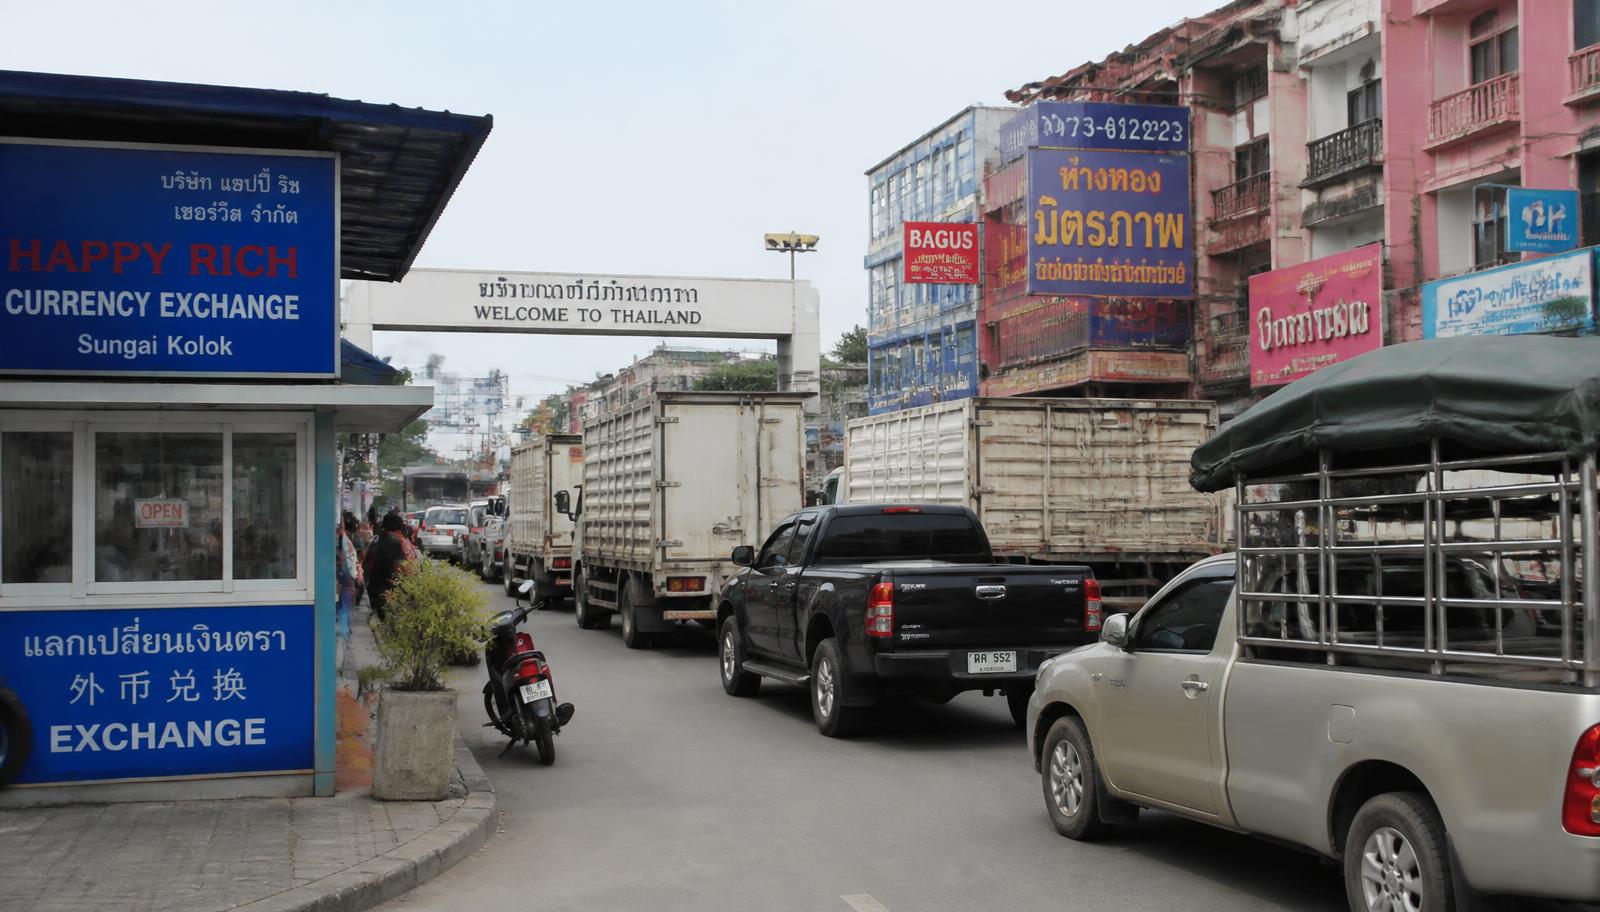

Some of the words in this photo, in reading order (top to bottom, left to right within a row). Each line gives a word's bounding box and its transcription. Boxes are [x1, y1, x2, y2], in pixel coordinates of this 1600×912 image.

[909, 229, 974, 250] BAGUS
[8, 238, 173, 276] HAPPY
[188, 243, 299, 279] RICH
[5, 288, 151, 318] CURRENCY
[159, 292, 300, 320] EXCHANGE
[473, 305, 569, 322] WELCOME
[577, 308, 601, 323] TO
[610, 309, 702, 325] THAILAND
[77, 333, 157, 360] Sungai
[167, 335, 233, 356] Kolok
[141, 503, 183, 520] OPEN
[24, 617, 287, 657] แลกเปลี่ยนเงินตรา
[50, 718, 267, 753] EXCHANGE
